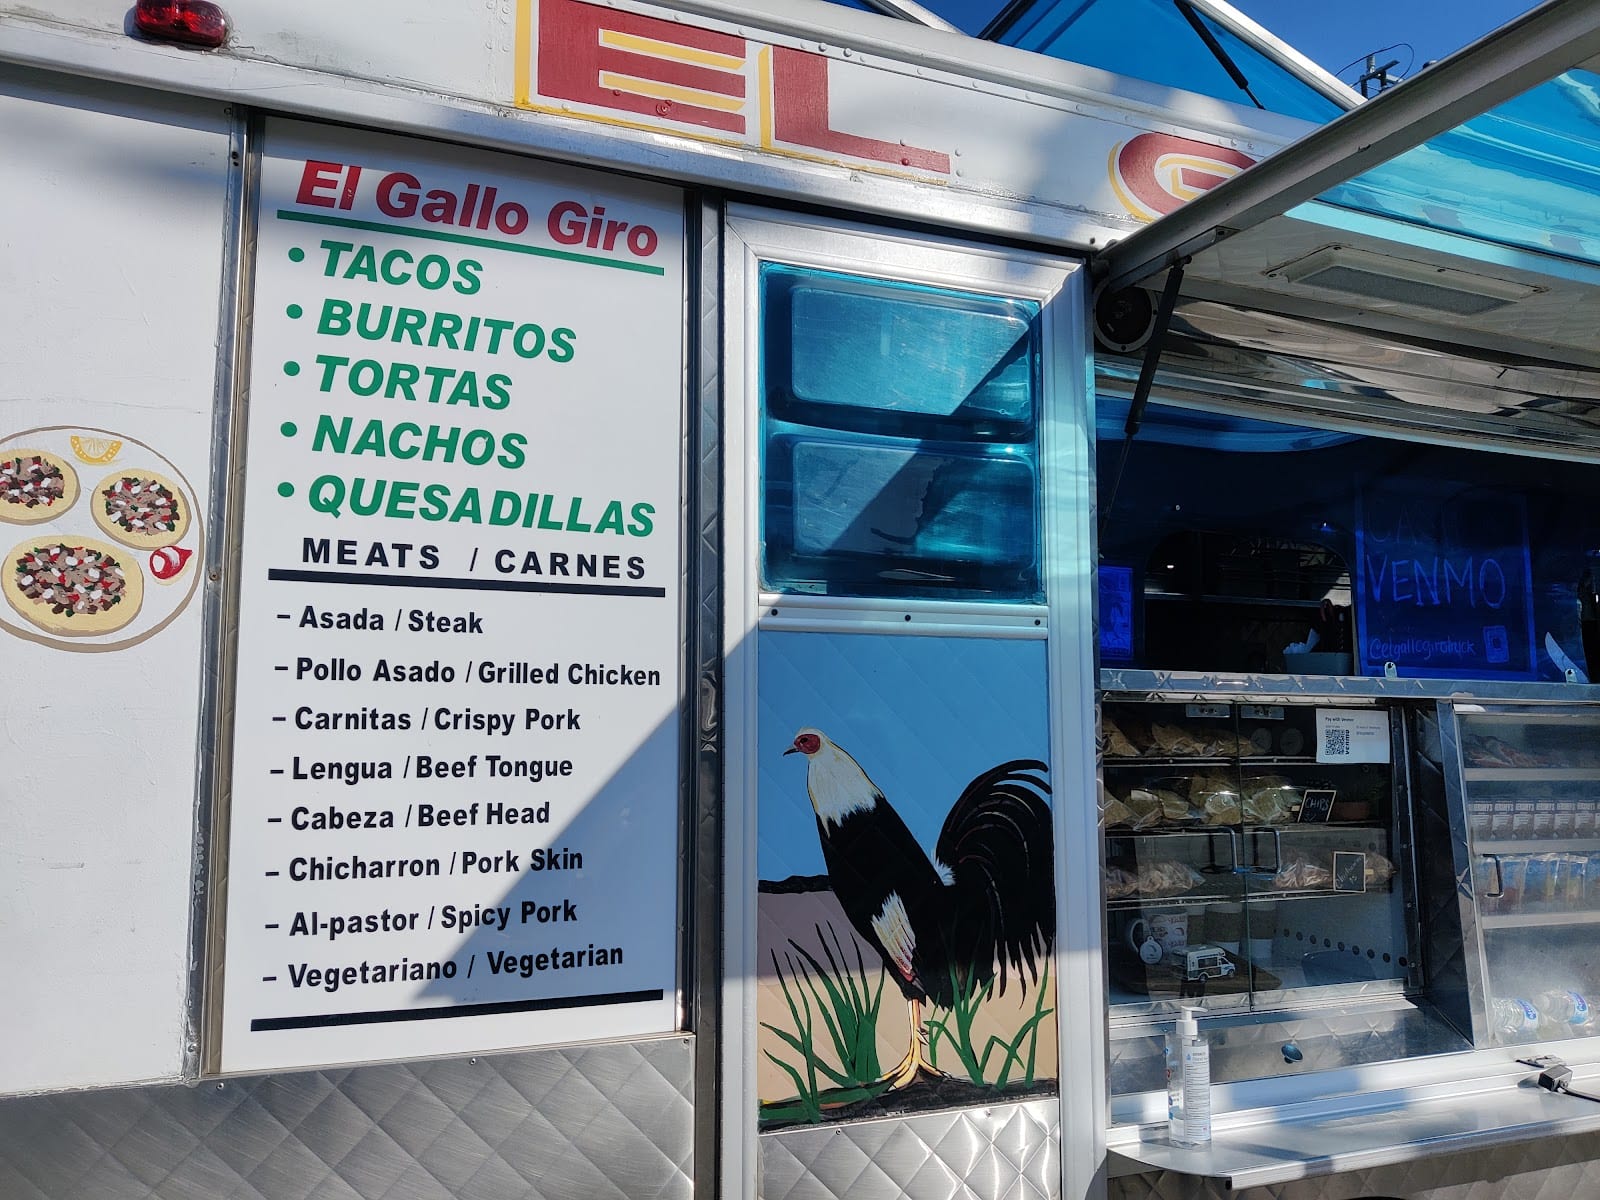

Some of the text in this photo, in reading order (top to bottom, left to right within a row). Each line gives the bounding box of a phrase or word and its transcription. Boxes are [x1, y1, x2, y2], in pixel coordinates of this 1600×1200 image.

[514, 0, 950, 186] EL
[295, 159, 658, 257] El Gallo Giro
[320, 240, 484, 295] TACOS
[316, 298, 577, 363] BURRITOS
[315, 354, 513, 411] TORTAS
[311, 414, 528, 470] NACHOS
[308, 474, 656, 538] QUESADILLAS
[301, 537, 440, 570] MEATS
[493, 549, 646, 580] CARNES
[1366, 553, 1506, 609] VENMO
[299, 605, 384, 631] Asada
[408, 609, 483, 634] Steak
[296, 657, 362, 682] Pollo
[372, 659, 455, 683] Asado
[478, 661, 559, 684] Grilled
[568, 663, 660, 686] Chicken
[295, 706, 411, 730] Carnitas
[434, 707, 516, 736] Crispy
[525, 708, 581, 730] Pork
[292, 756, 392, 786] Lengua
[416, 755, 478, 778] Beef
[485, 755, 573, 783] Tongue
[291, 806, 394, 831] Cabeza
[418, 802, 479, 827] Beef
[486, 801, 550, 825] Head
[1304, 796, 1330, 811] CHIPS
[289, 855, 440, 882] Chicharron
[462, 850, 520, 874] Pork
[530, 847, 583, 872] Skin
[289, 909, 419, 941] Al-pastor
[441, 903, 511, 934] Spicy
[521, 898, 578, 924] Pork
[287, 957, 458, 993] Vegetariano
[486, 943, 623, 979] Vegetarian
